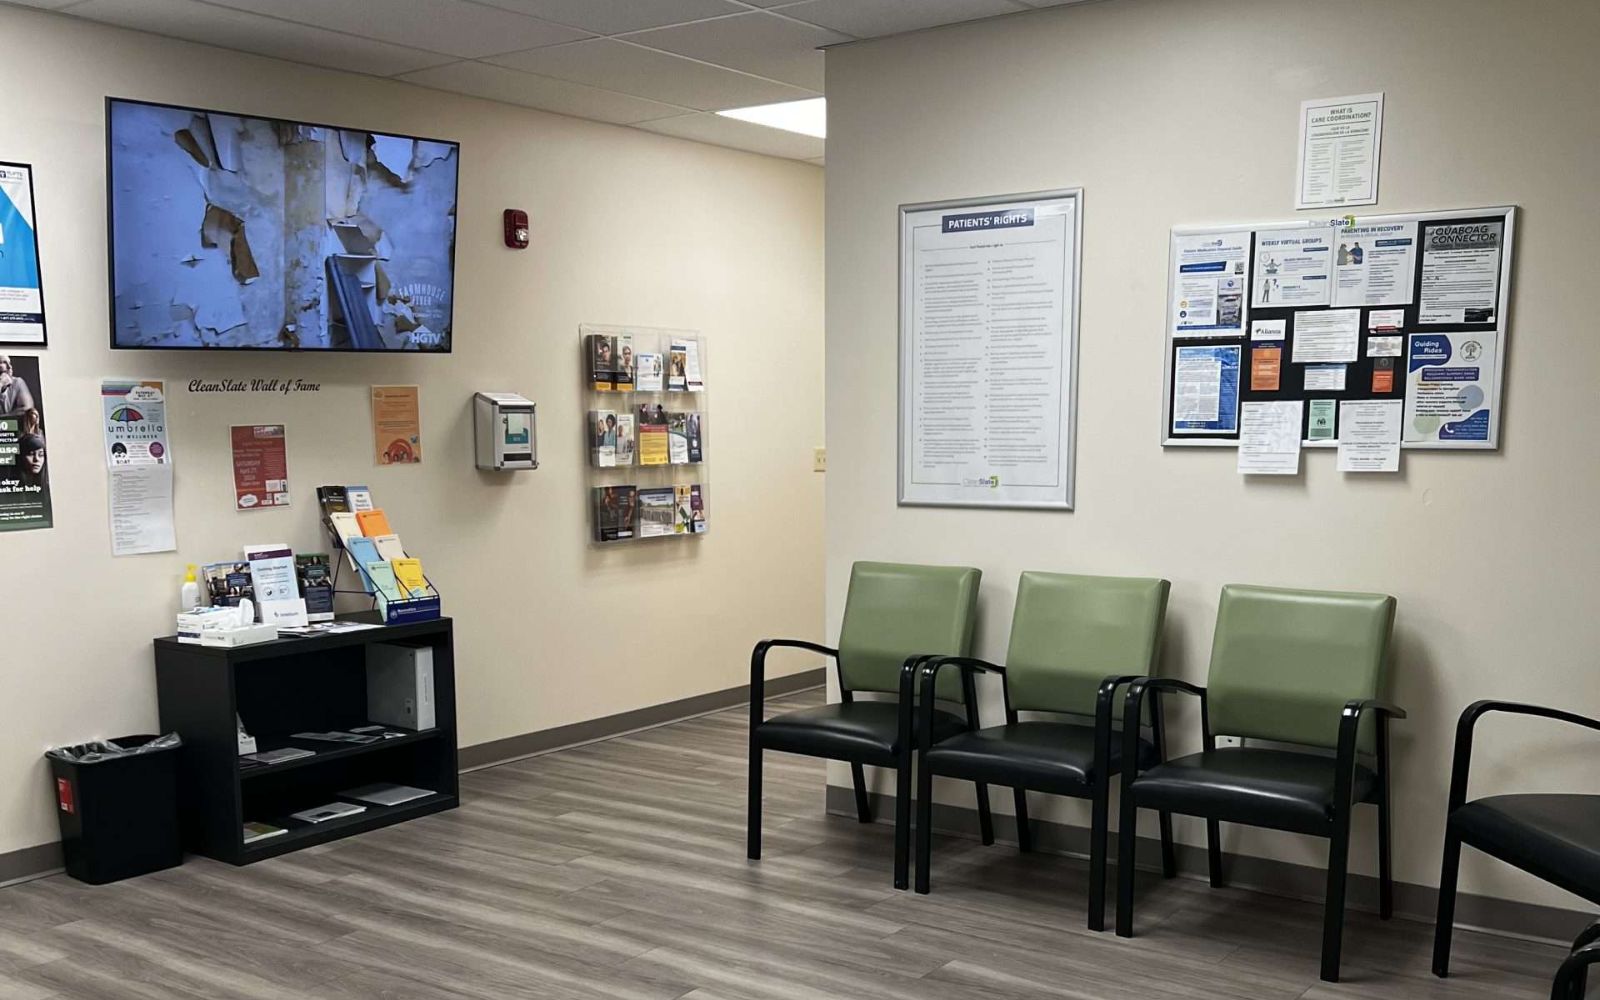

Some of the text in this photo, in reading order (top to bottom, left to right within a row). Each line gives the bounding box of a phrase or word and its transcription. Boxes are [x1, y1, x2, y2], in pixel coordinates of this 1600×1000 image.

[948, 214, 1027, 229] PATIENTS' RIGHTS
[1435, 225, 1489, 236] QUABOAG
[1431, 232, 1497, 244] CONNECTOR
[411, 332, 441, 344] HGTV
[187, 378, 321, 395] CleanSlate Wall of Fame
[108, 422, 163, 433] umbrella
[1, 479, 20, 487] okay
[24, 485, 42, 493] help
